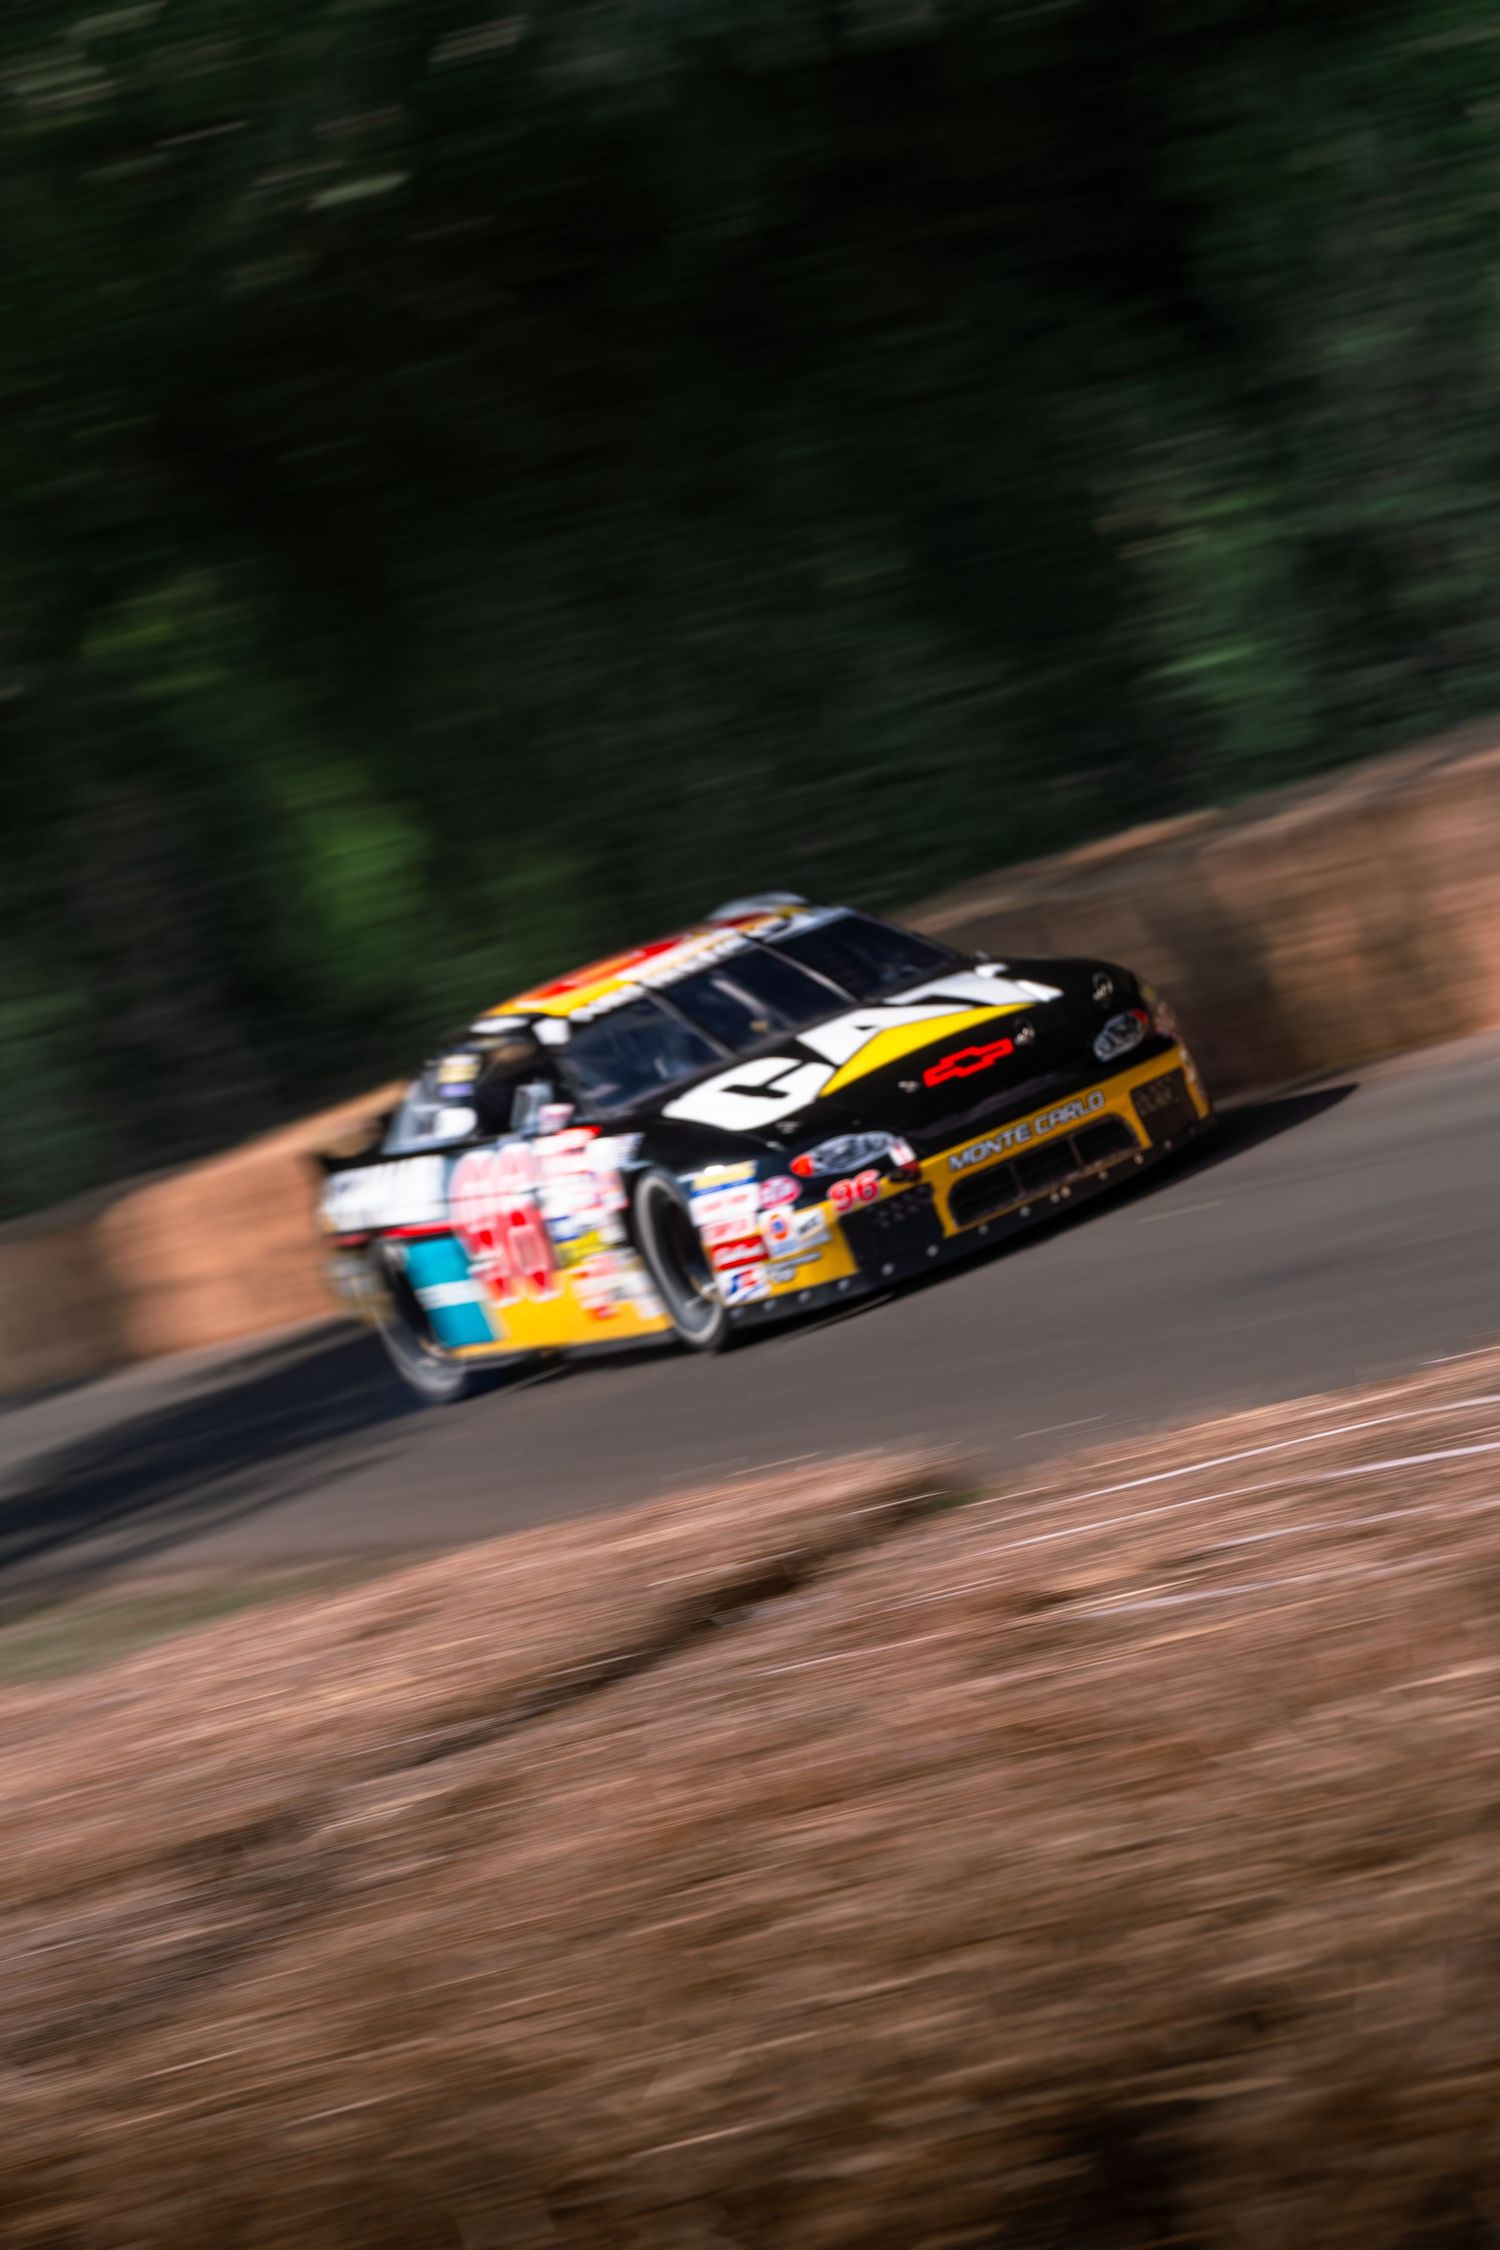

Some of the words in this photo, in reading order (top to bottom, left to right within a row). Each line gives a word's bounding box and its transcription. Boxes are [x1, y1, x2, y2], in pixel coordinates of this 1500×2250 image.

[949, 1122, 1030, 1171] MONTE
[1034, 1090, 1105, 1135] CARLO
[827, 1168, 881, 1213] 96
